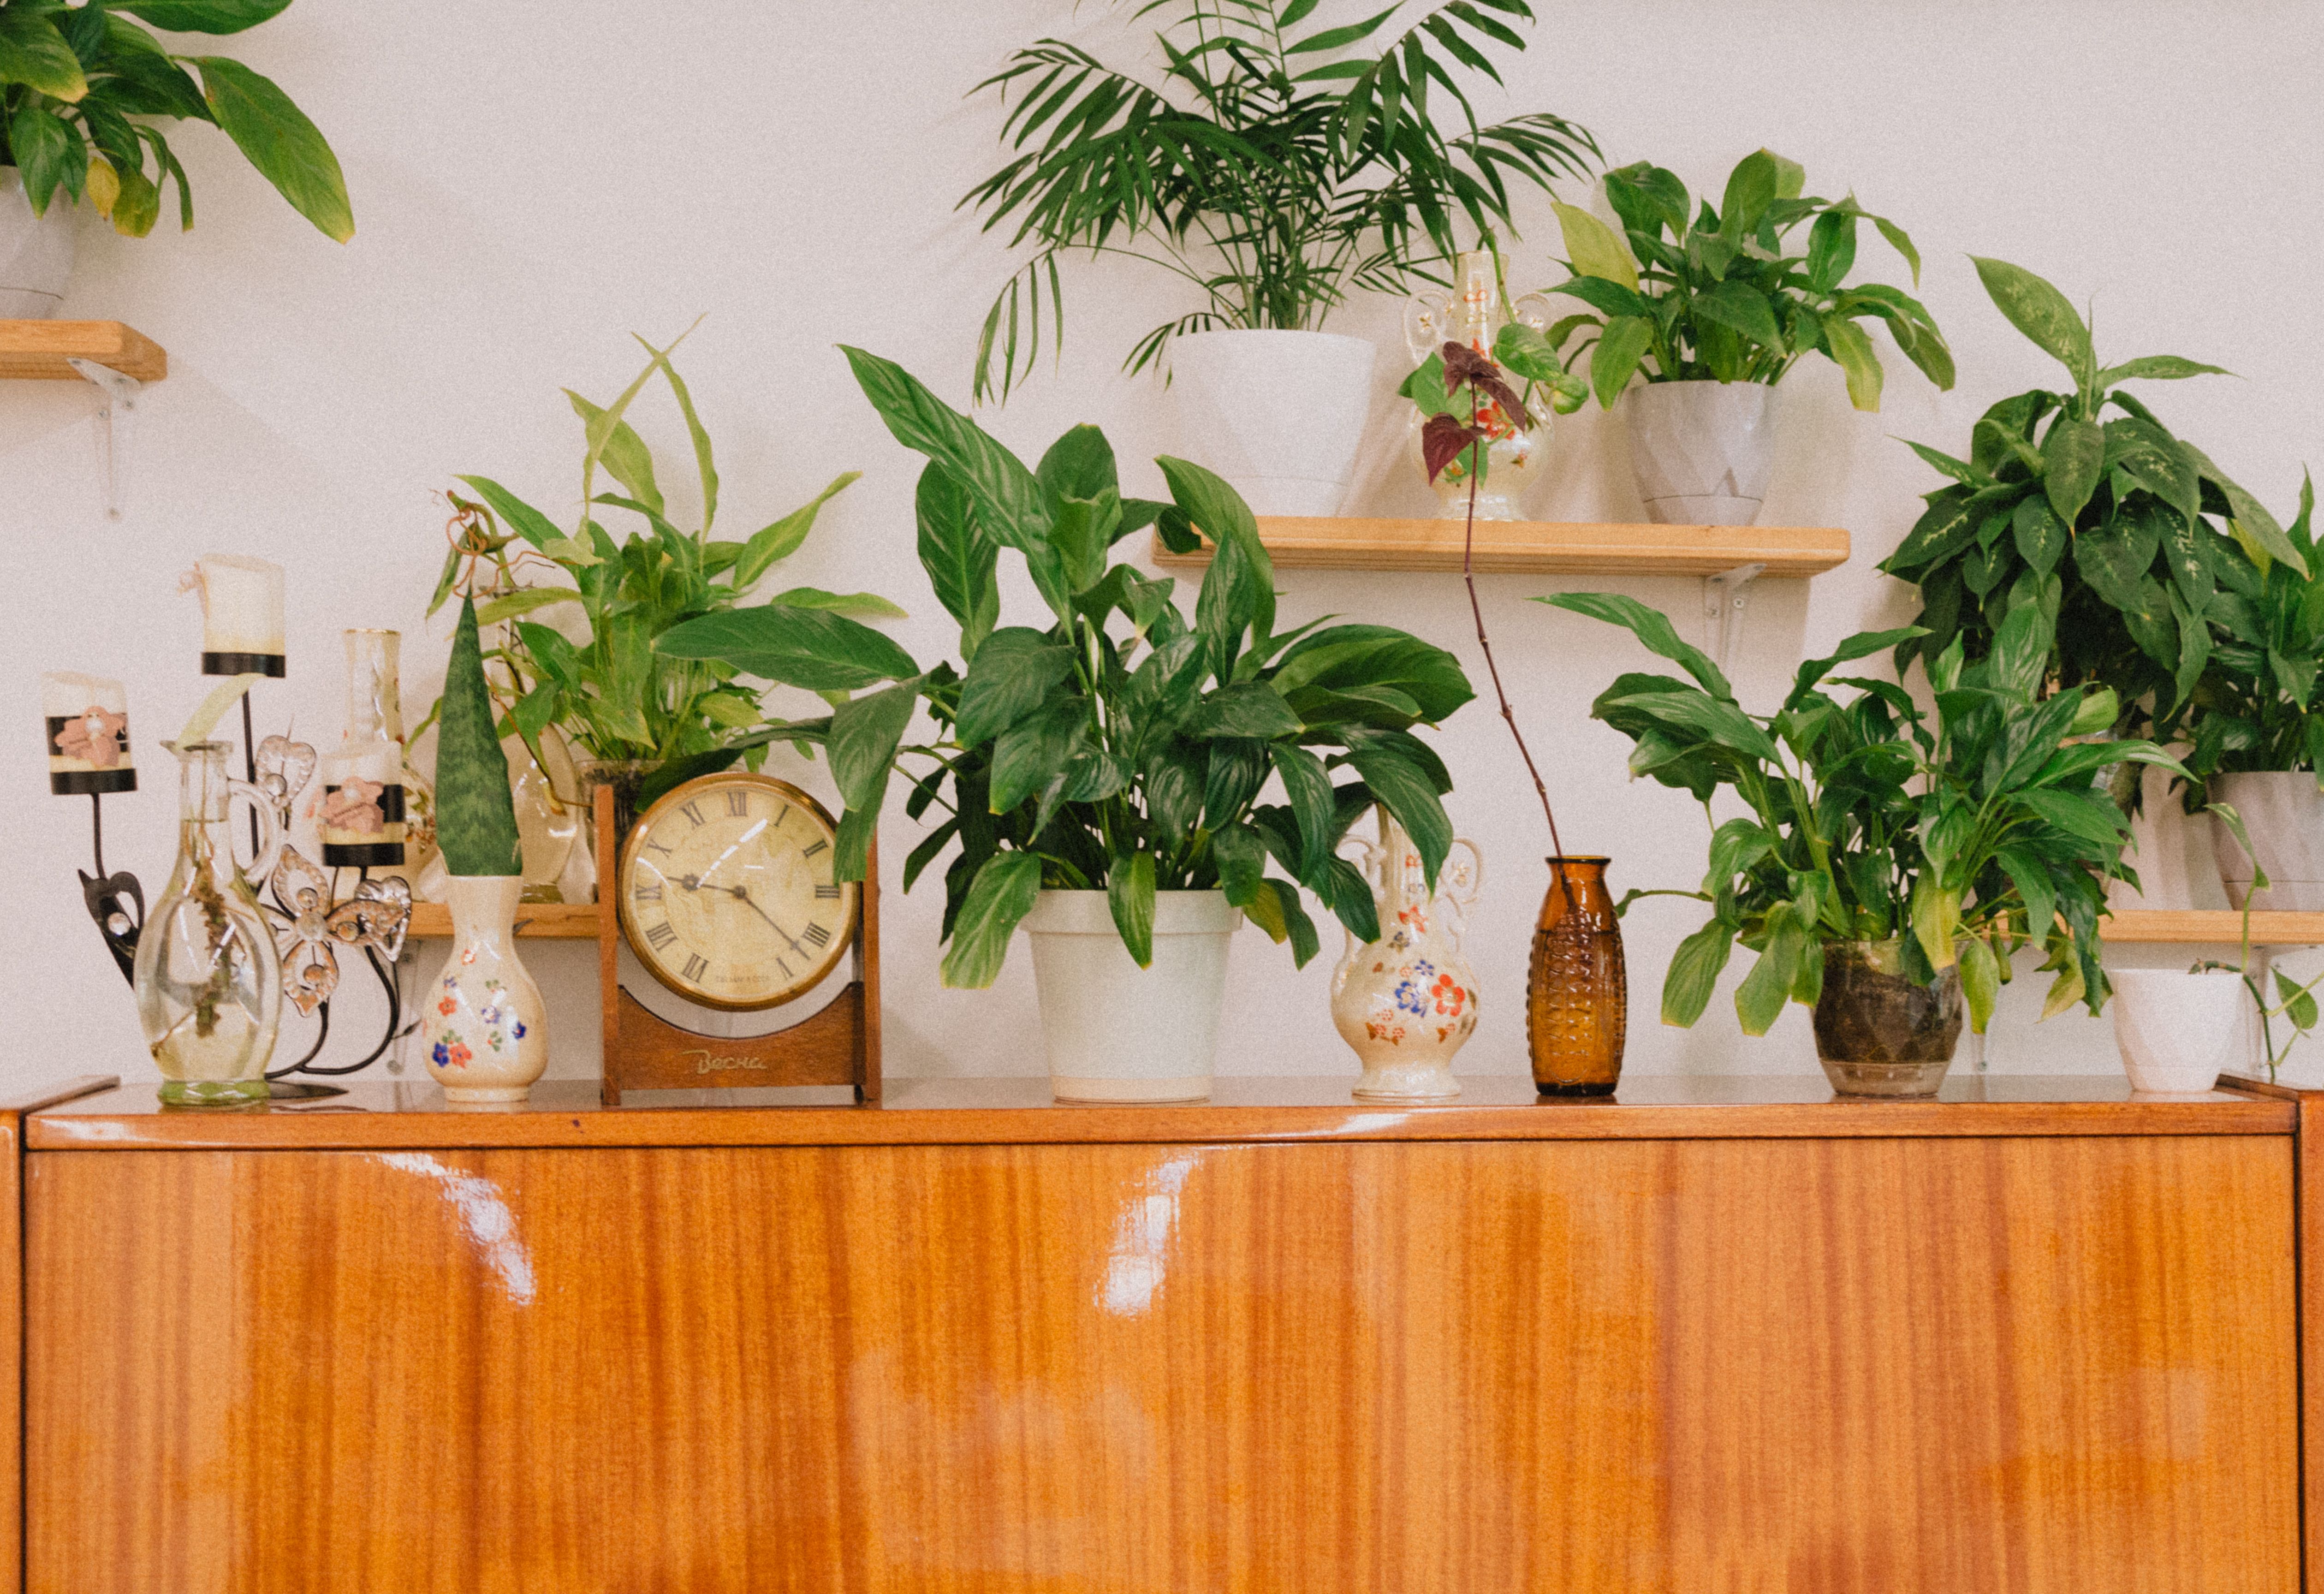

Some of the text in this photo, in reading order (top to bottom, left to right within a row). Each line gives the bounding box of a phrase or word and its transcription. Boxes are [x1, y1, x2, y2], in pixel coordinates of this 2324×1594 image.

[646, 836, 672, 859] X
[802, 838, 829, 859] II
[814, 884, 840, 898] III
